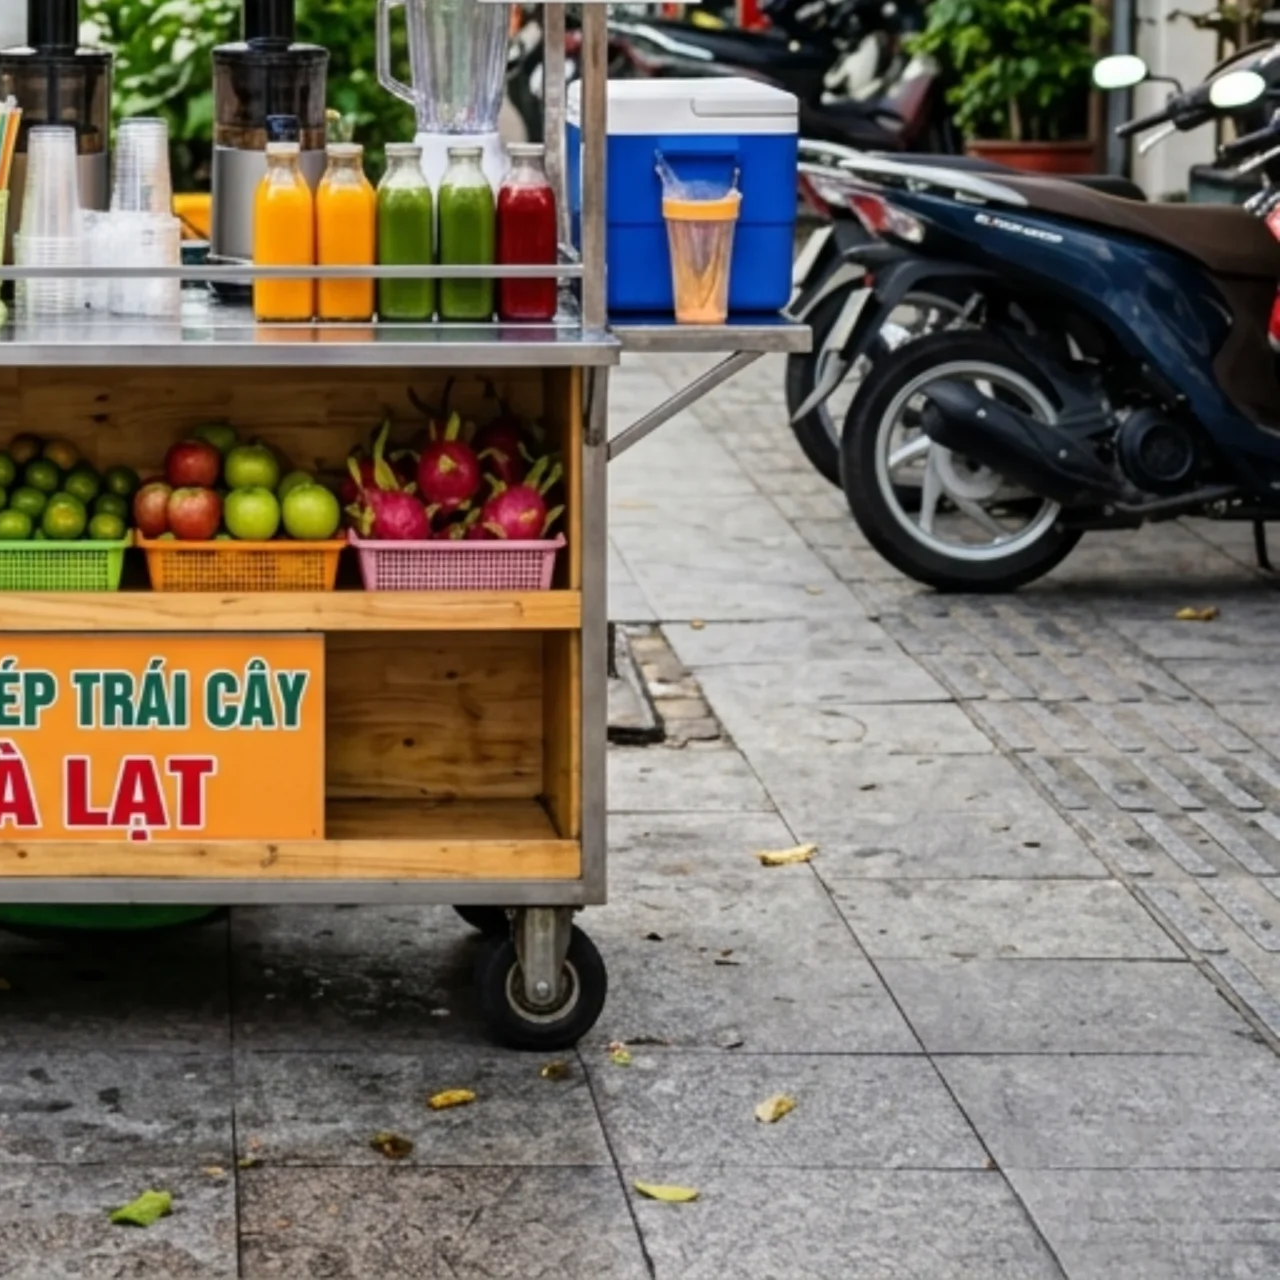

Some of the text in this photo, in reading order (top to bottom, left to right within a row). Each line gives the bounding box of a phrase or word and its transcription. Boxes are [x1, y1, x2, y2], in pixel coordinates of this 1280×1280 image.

[72, 658, 187, 727] TRÁI
[205, 660, 308, 727] CÂY
[66, 757, 214, 840] LẠT
